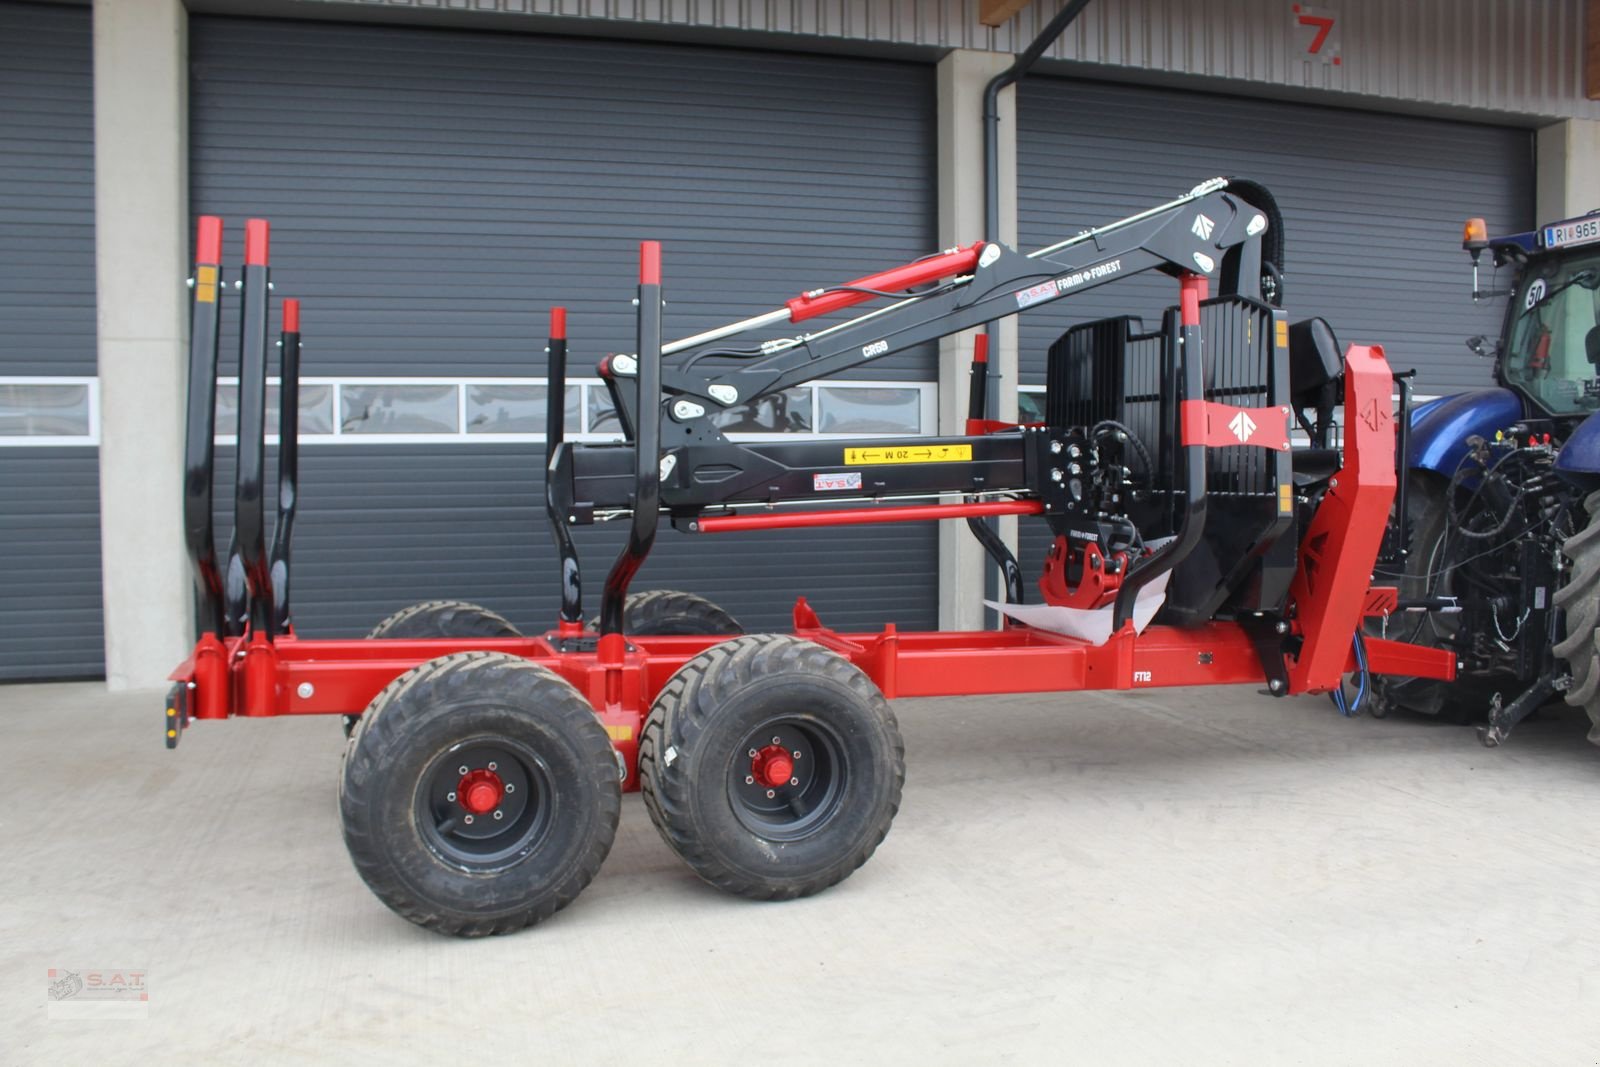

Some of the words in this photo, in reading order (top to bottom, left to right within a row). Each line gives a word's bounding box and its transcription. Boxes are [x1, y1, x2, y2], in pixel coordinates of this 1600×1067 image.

[1298, 15, 1335, 54] 7
[1556, 228, 1567, 242] RI
[1056, 273, 1083, 290] FARMI
[1090, 260, 1121, 279] FOREST
[885, 451, 894, 459] M
[896, 450, 909, 459] 20
